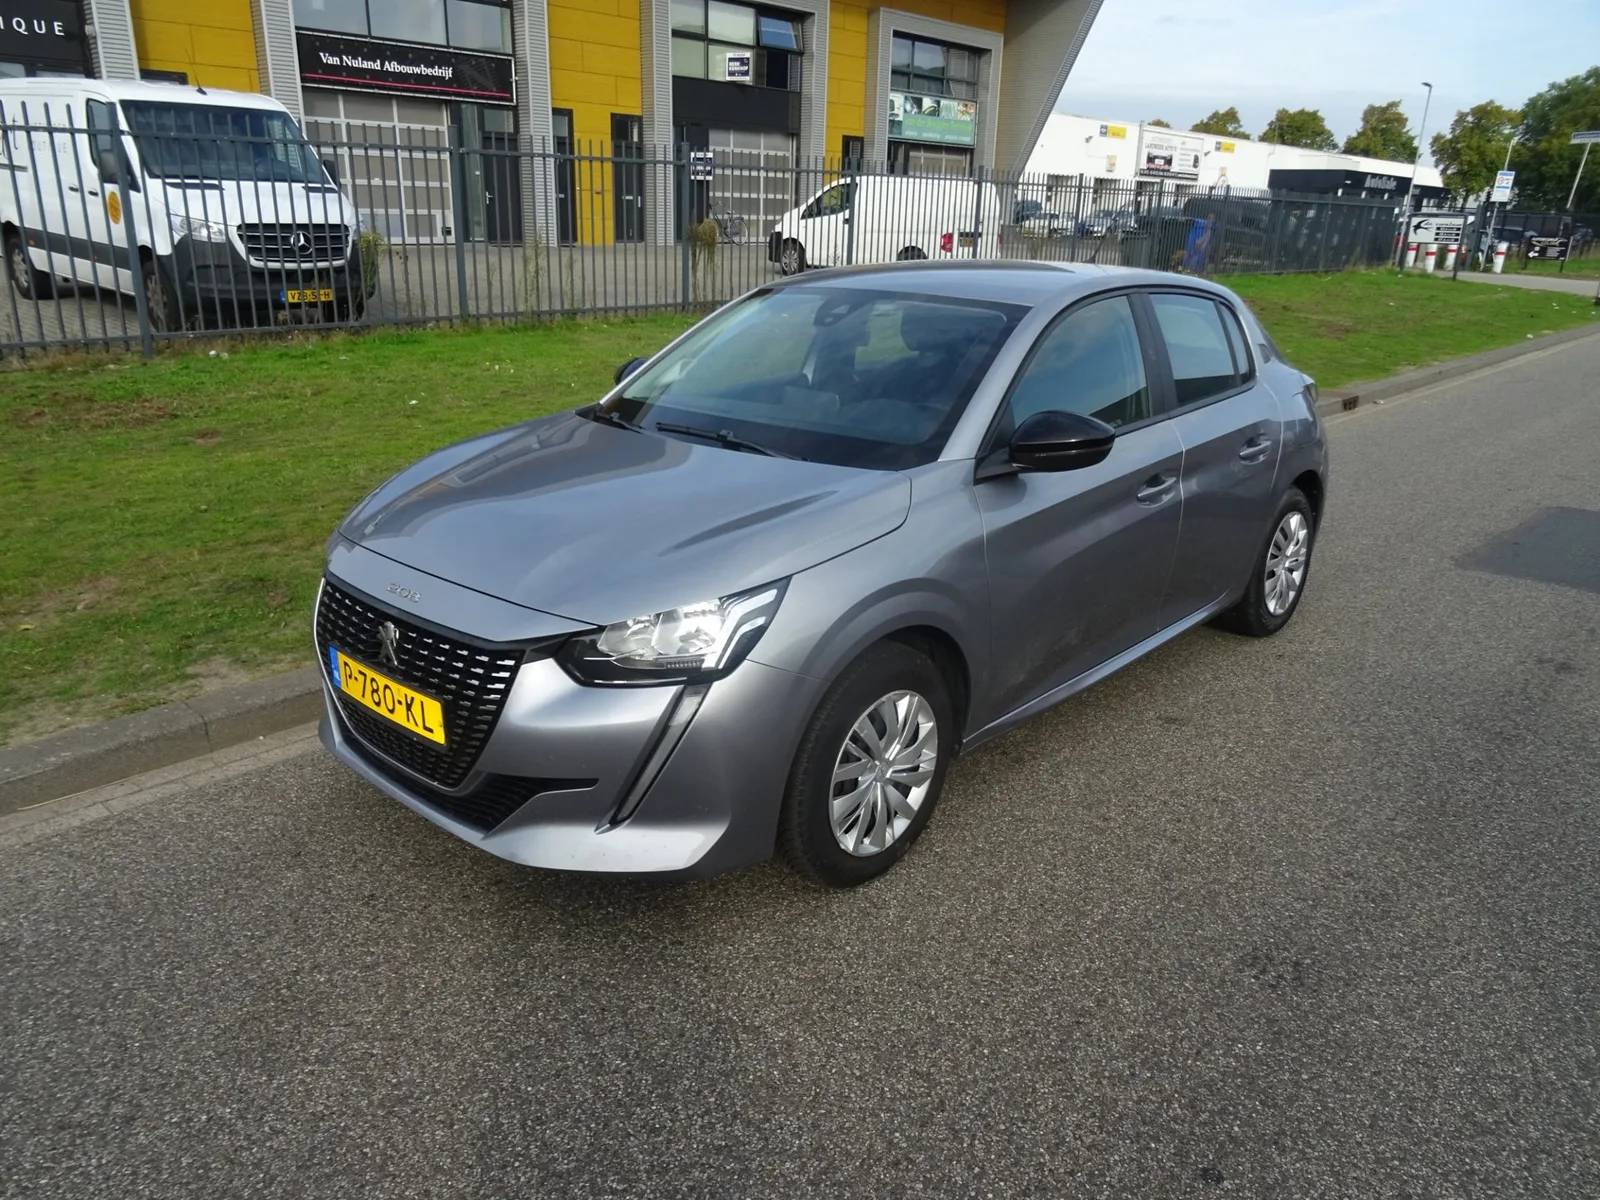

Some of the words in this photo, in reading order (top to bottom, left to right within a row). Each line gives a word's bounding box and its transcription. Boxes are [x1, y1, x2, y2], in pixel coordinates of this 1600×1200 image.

[319, 52, 341, 66] Van
[342, 55, 381, 71] Nuland
[383, 61, 453, 80] Afbouwbedrijf
[1364, 174, 1398, 190] AutoSale
[387, 583, 422, 603] 208
[343, 660, 434, 734] P-780-KL
